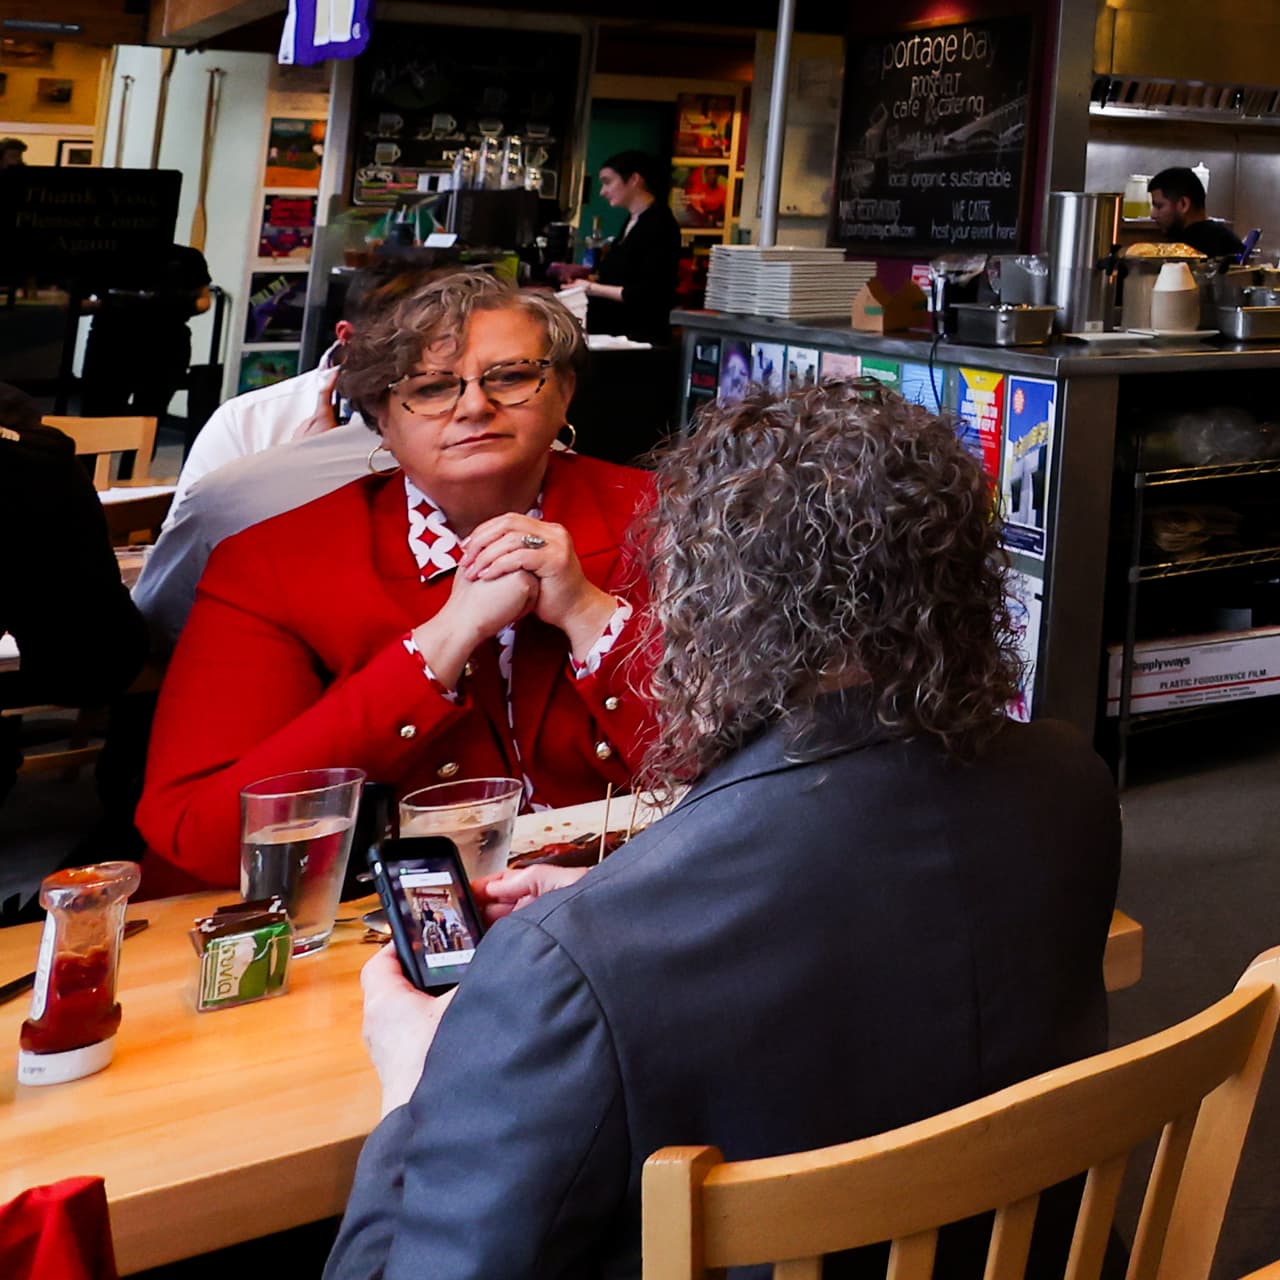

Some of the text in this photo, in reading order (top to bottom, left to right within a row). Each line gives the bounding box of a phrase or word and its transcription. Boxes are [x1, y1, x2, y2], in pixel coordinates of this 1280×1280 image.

[881, 26, 998, 80] portage bay
[949, 167, 1012, 188] sustainable
[1160, 669, 1266, 690] PLASTIC FOODSERVICE FILM
